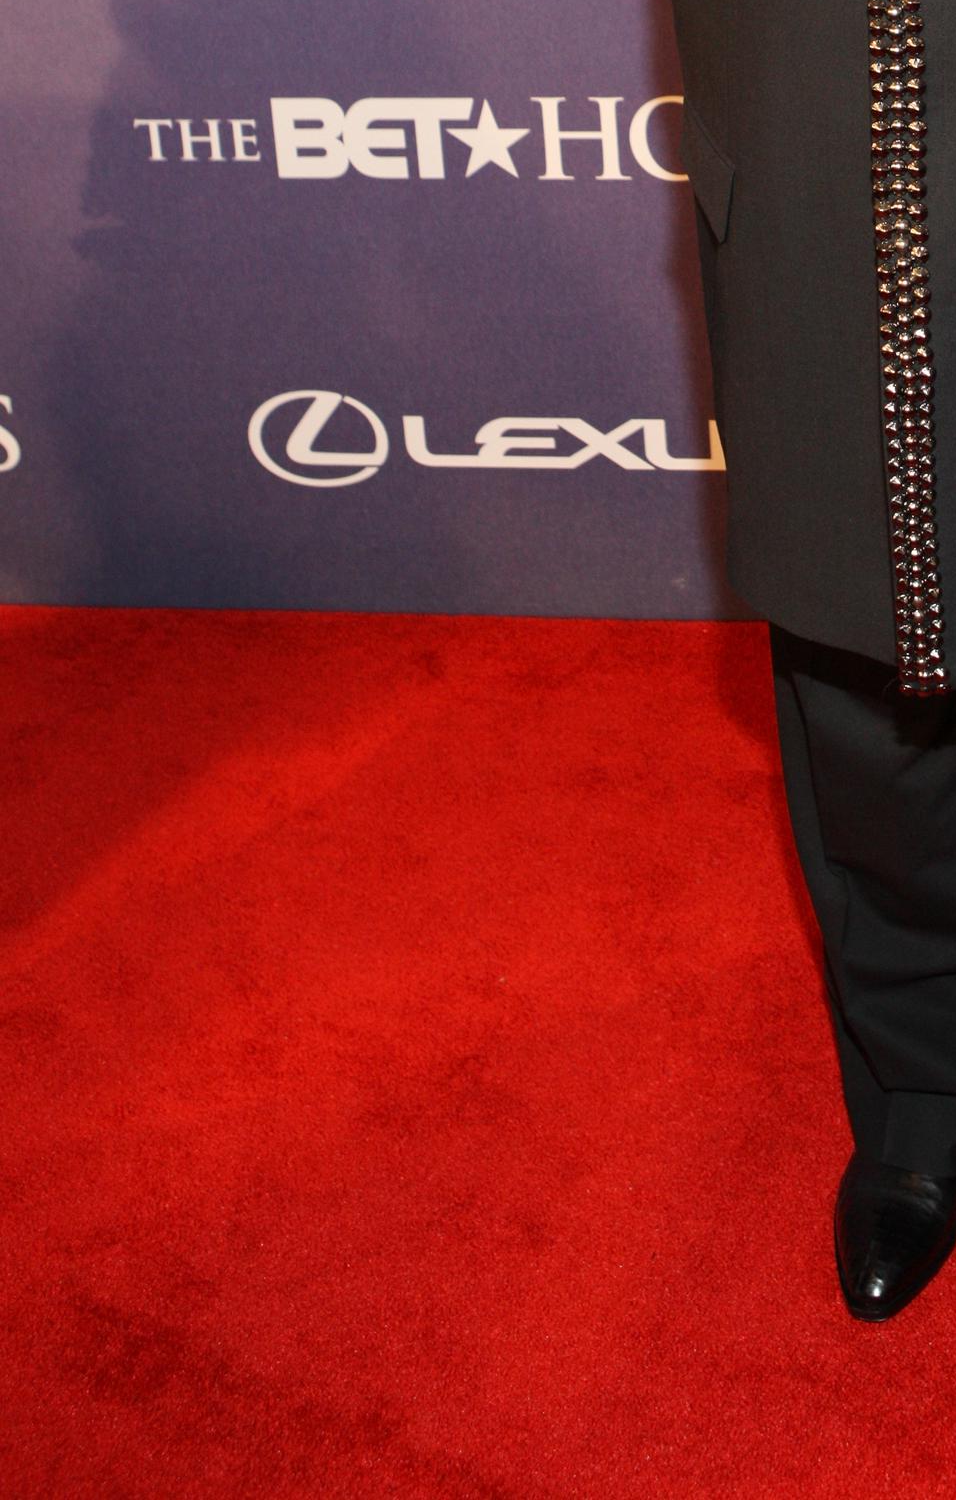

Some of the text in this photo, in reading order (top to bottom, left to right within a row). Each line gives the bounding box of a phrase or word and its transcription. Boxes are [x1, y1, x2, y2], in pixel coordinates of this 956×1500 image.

[133, 118, 261, 161] THE
[270, 97, 475, 180] BET
[402, 415, 728, 471] LEXU
